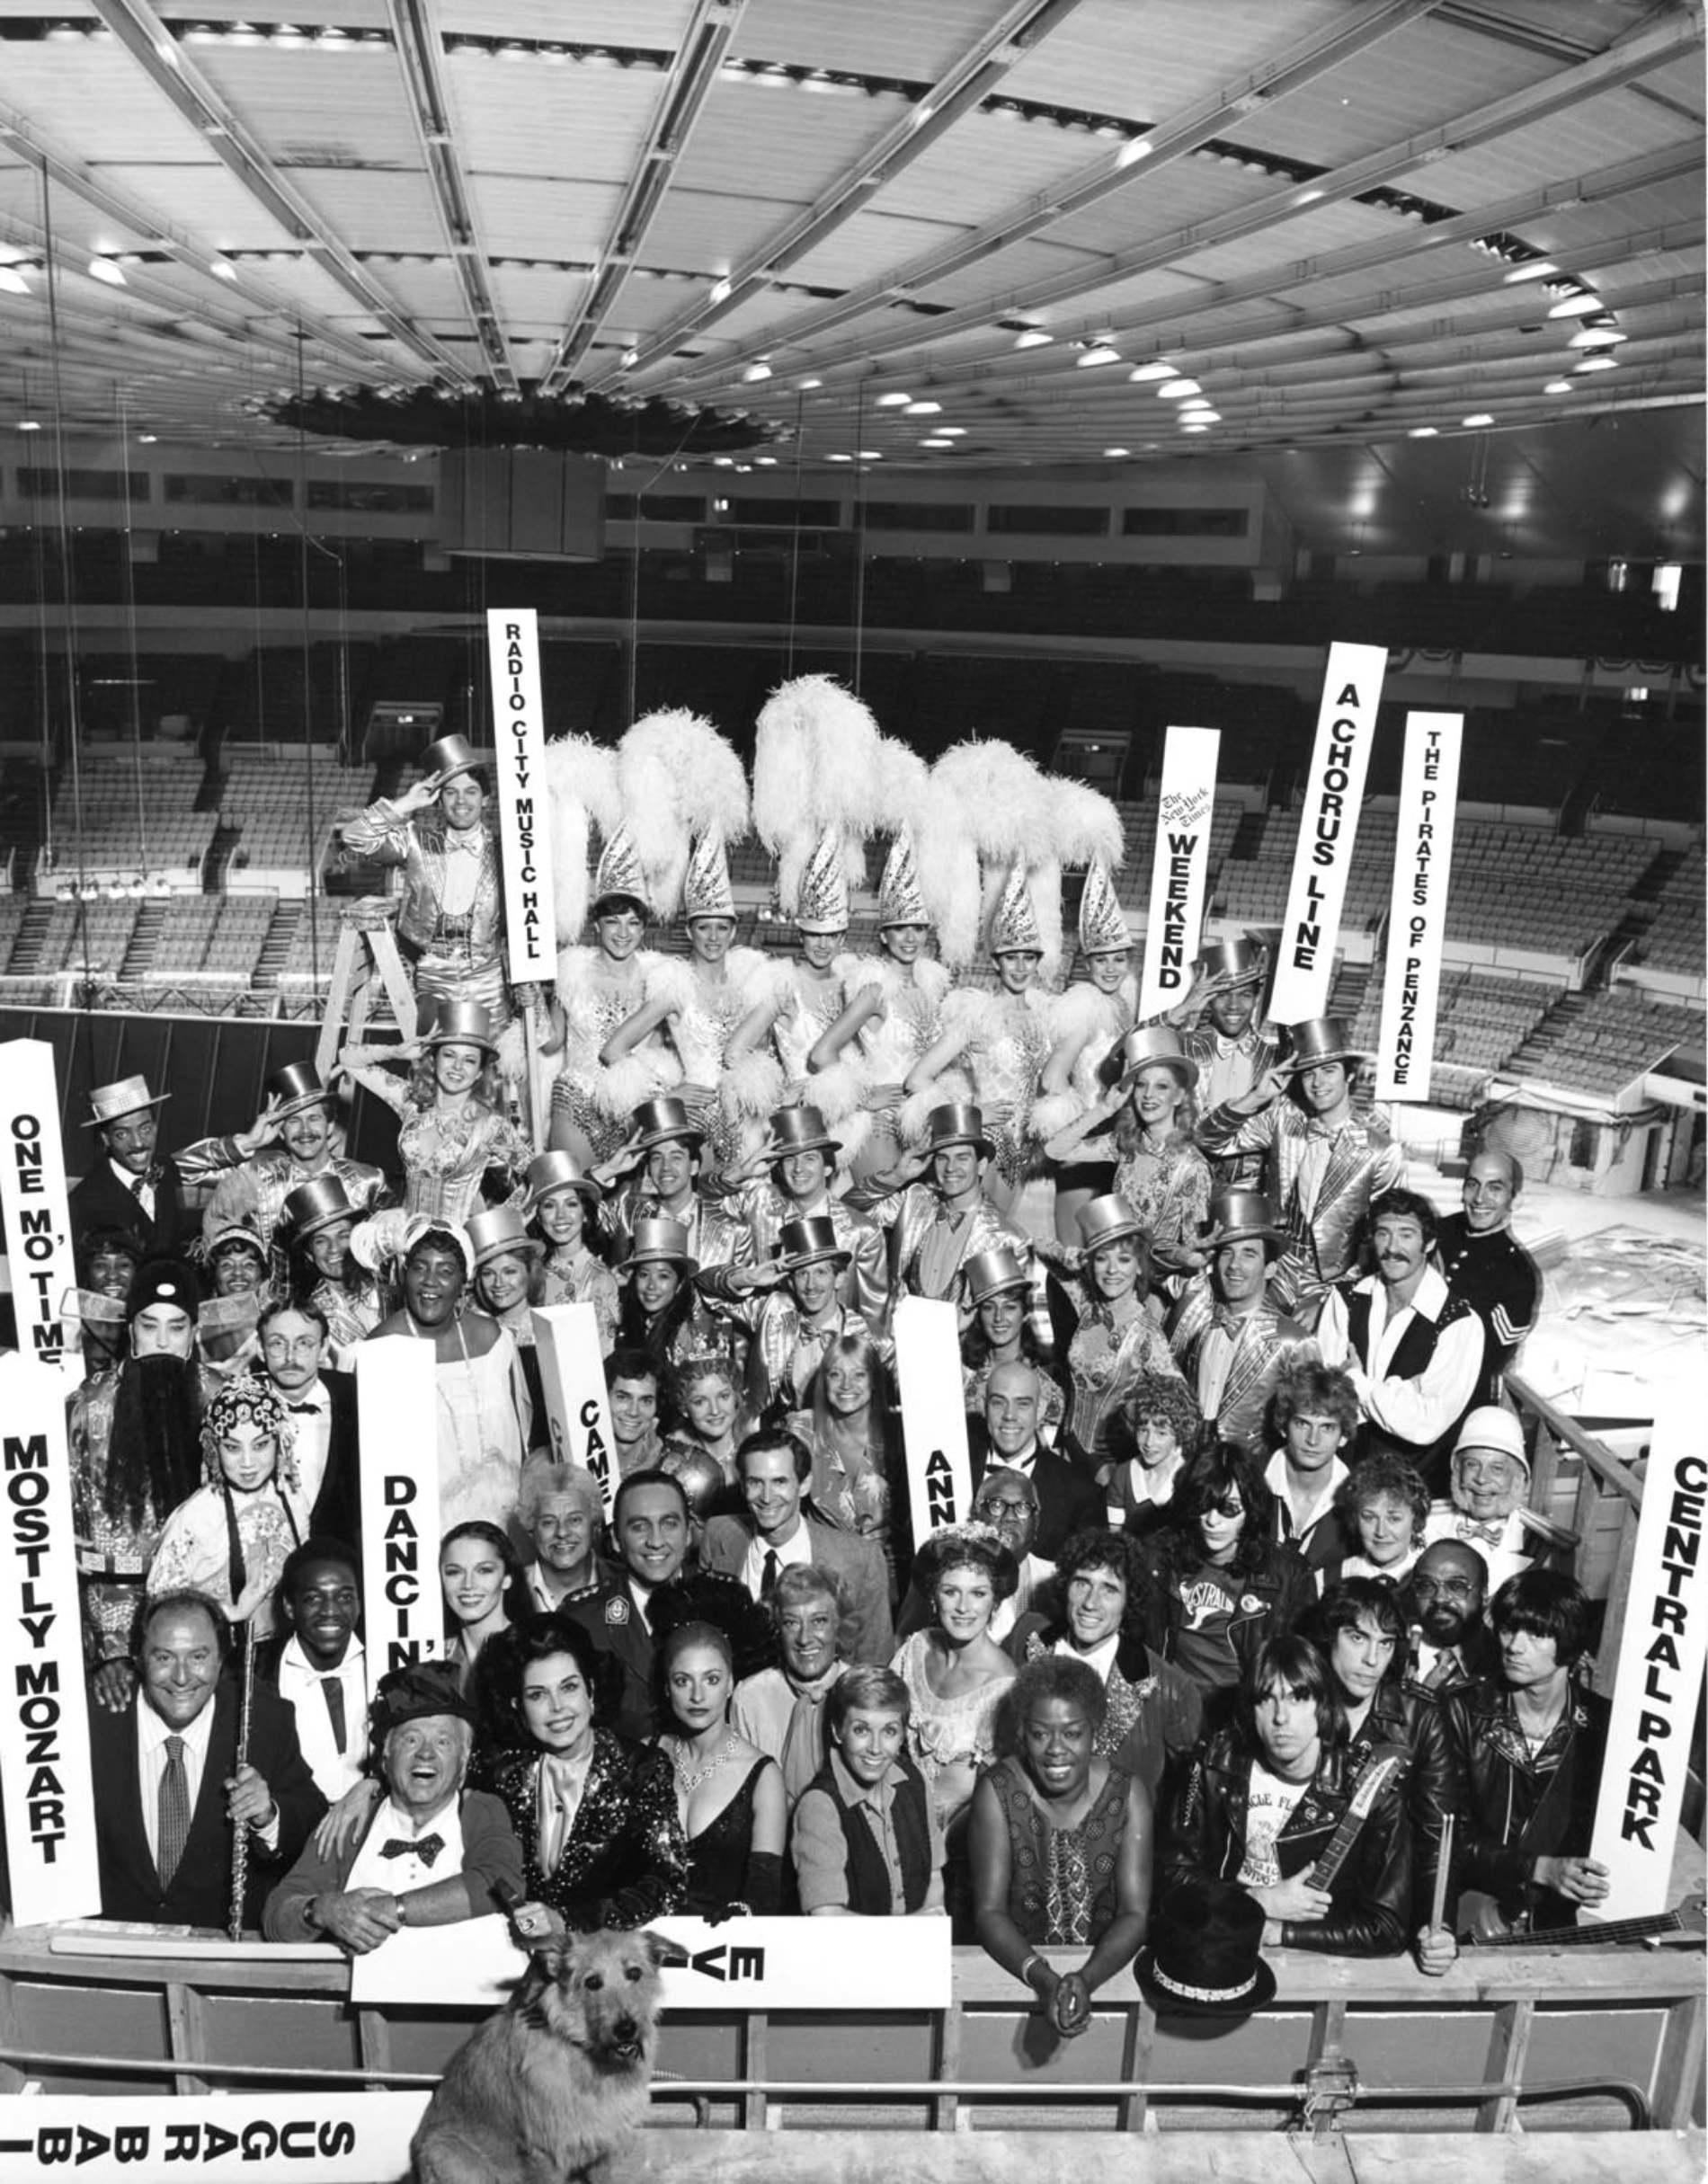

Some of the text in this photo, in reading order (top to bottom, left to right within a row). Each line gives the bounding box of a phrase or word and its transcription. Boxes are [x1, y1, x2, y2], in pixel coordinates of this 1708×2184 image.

[506, 624, 540, 959] RADIO CITY MUSIC HALL
[1159, 833, 1198, 989] WEEKEND
[1293, 683, 1360, 971] A CHORUS LINE
[1393, 732, 1441, 1085] THE PIRATES OF PENZANCE
[11, 1114, 44, 1194] ONE
[20, 1209, 65, 1261] MO'
[3, 1434, 66, 1864] MOSTLY MOZART
[384, 1475, 435, 1673] DANCIN'
[1621, 1456, 1707, 1851] CENTRAL PARK
[165, 2120, 355, 2162] SUGAR
